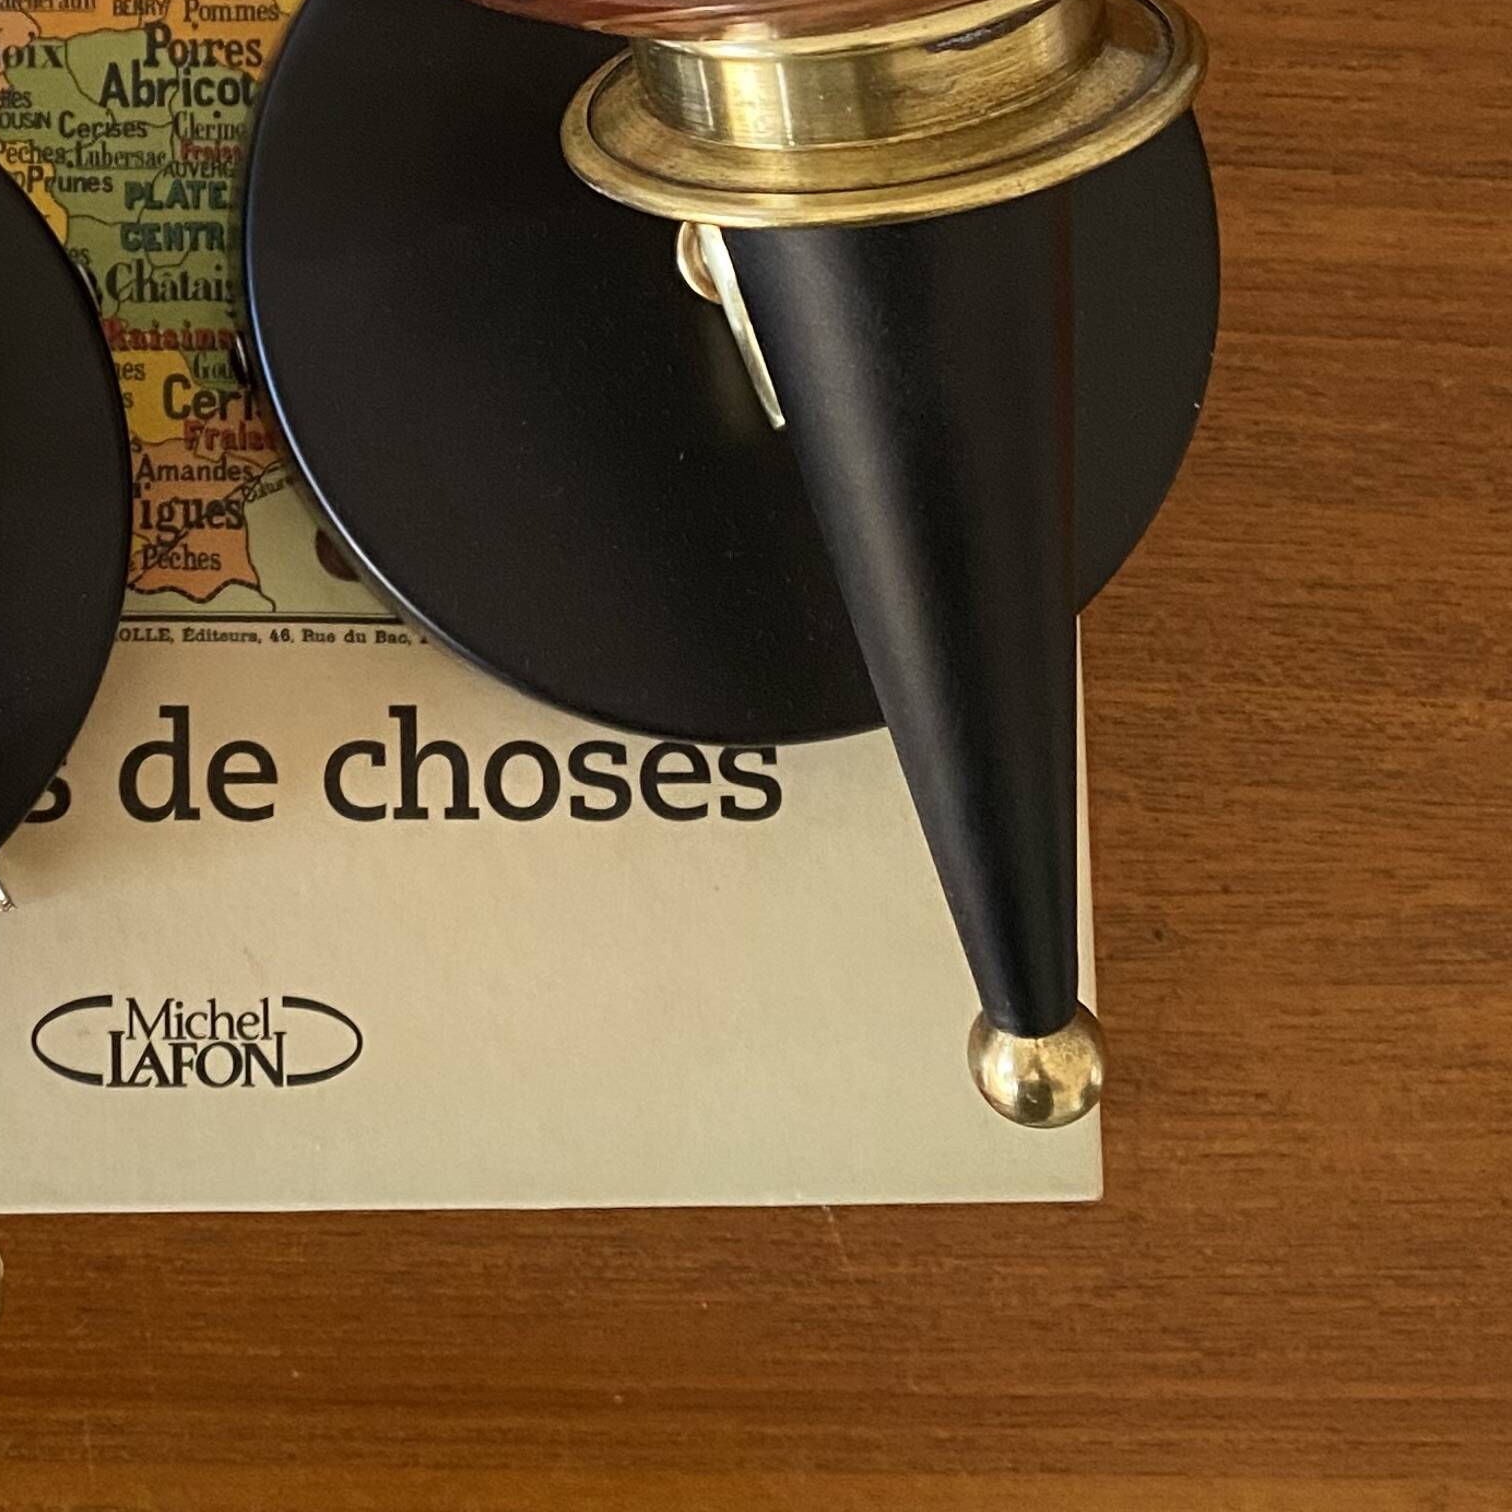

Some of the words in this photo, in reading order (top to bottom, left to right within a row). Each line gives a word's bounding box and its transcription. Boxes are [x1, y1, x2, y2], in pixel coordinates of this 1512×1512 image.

[143, 20, 263, 68] Poires
[58, 110, 148, 139] Cerises
[26, 164, 115, 194] Prunes
[124, 178, 233, 211] PLATE
[119, 221, 236, 253] CENTR
[136, 453, 255, 482] Amandes
[301, 629, 336, 644] Rue
[343, 627, 367, 644] du
[118, 705, 279, 823] de
[323, 705, 783, 823] choses
[125, 996, 274, 1041] Michel
[105, 1030, 288, 1089] LAFON
